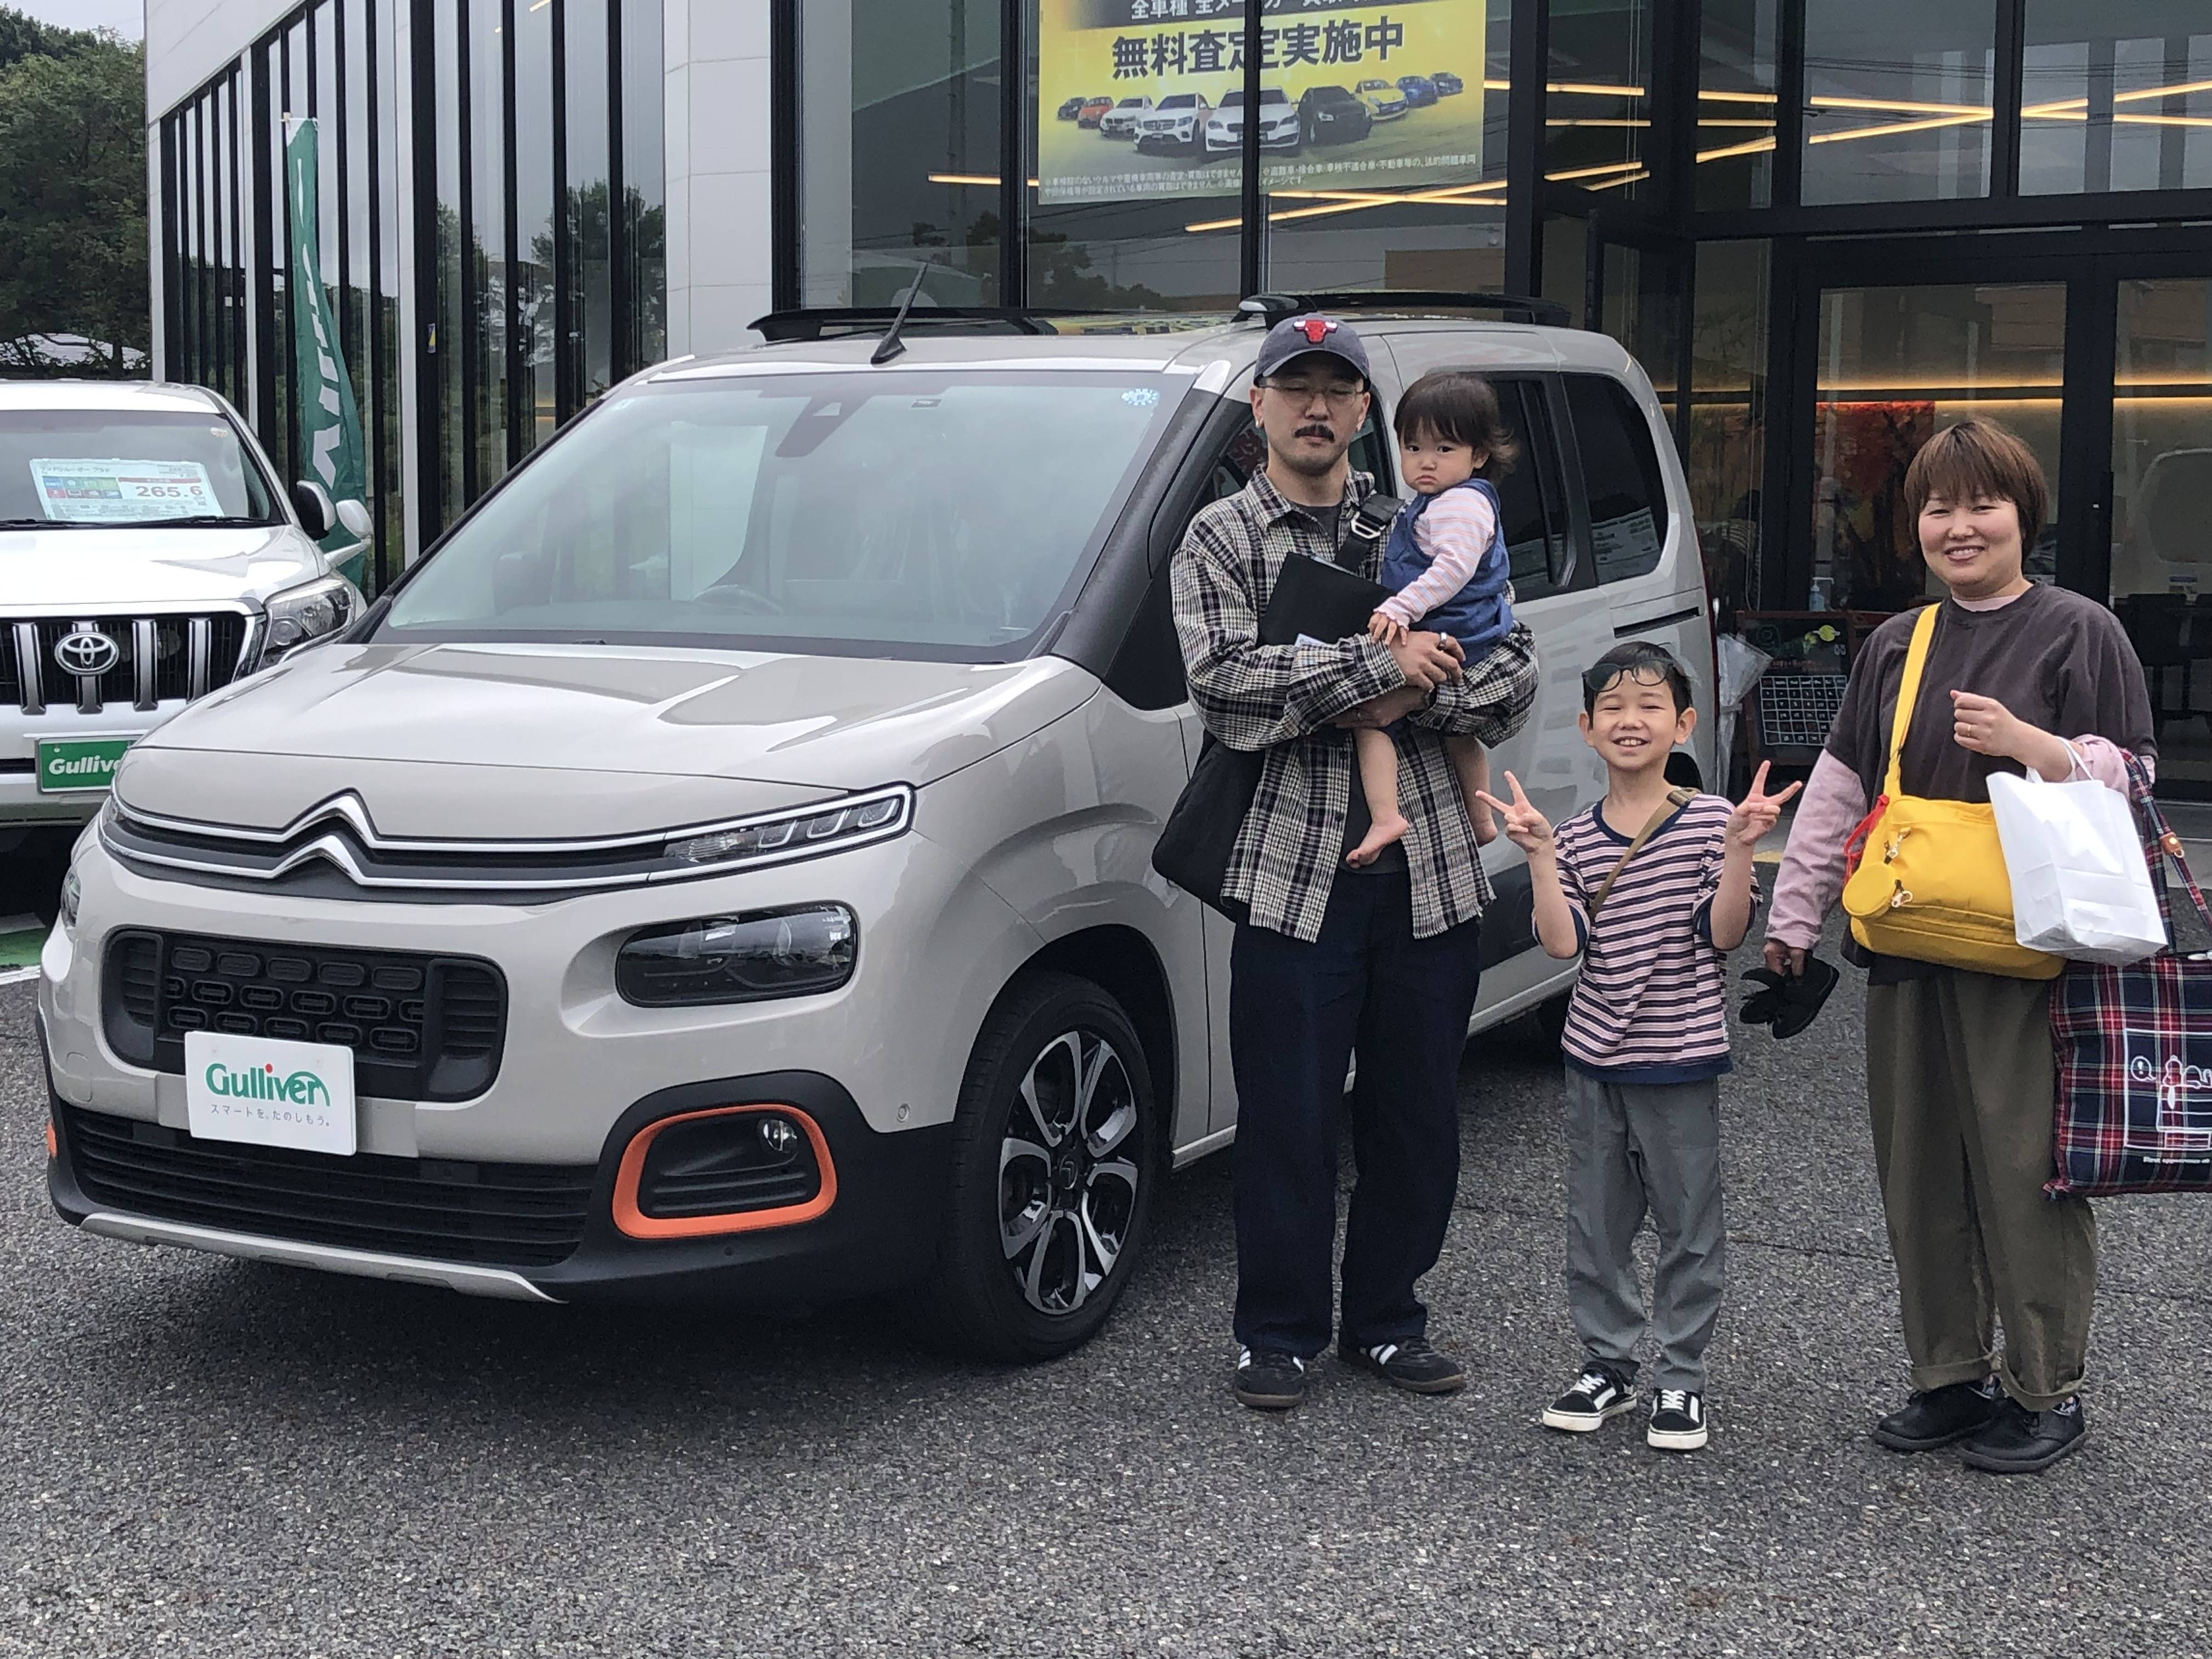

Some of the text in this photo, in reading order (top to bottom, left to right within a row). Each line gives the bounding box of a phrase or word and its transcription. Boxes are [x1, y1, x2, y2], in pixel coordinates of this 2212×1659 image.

[1113, 15, 1403, 80] 無料査定実施中
[136, 486, 203, 497] 265.6
[205, 1063, 330, 1107] Gulliver
[211, 1104, 330, 1127] スマートを、たのしもう。
